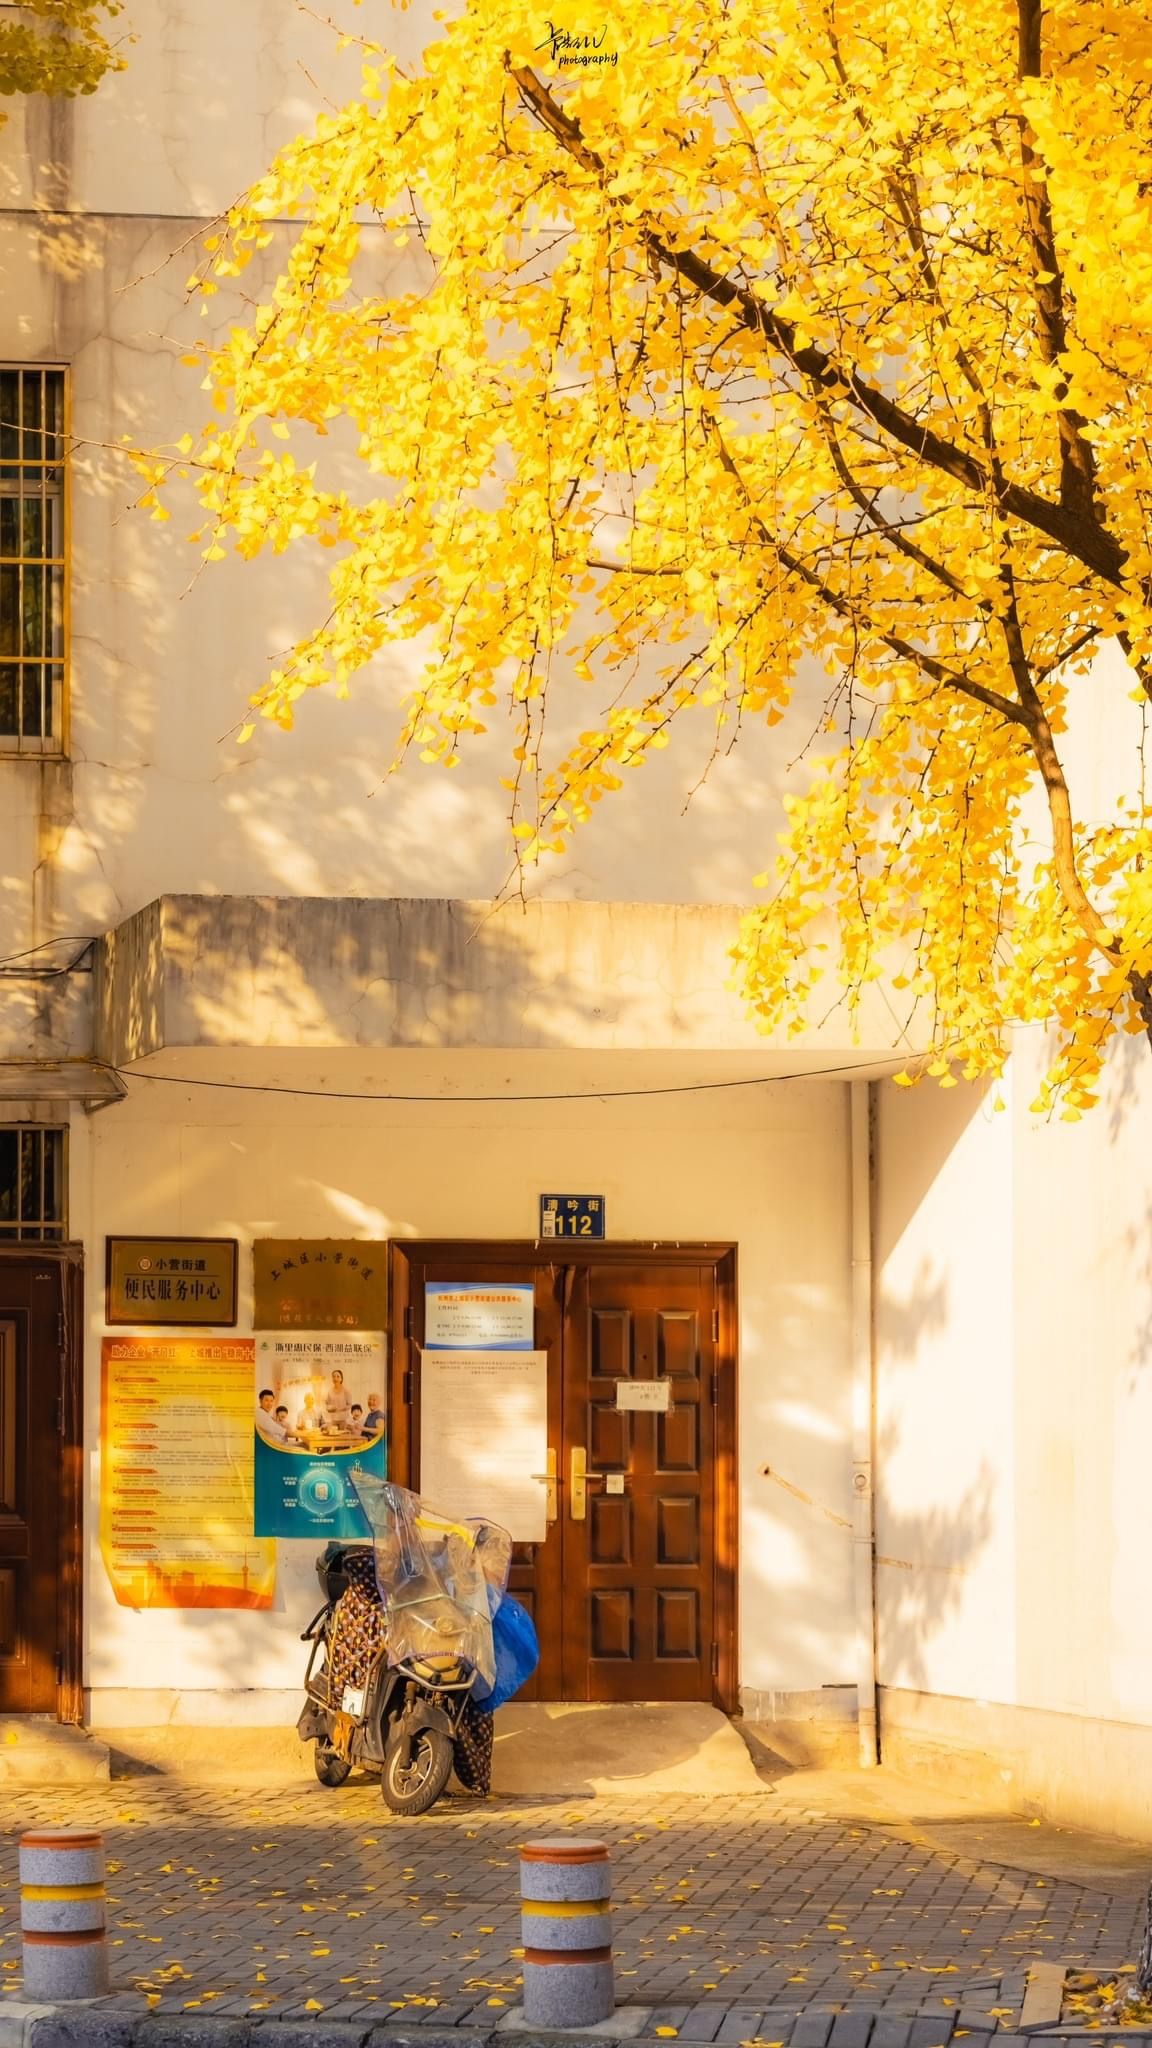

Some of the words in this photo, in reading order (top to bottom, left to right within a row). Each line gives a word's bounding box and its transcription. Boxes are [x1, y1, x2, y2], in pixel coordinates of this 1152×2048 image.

[555, 1215, 592, 1235] 112
[155, 1258, 206, 1271] 小营街道
[270, 1251, 374, 1282] 上城区小营街道
[125, 1277, 221, 1301] 便民服务中心
